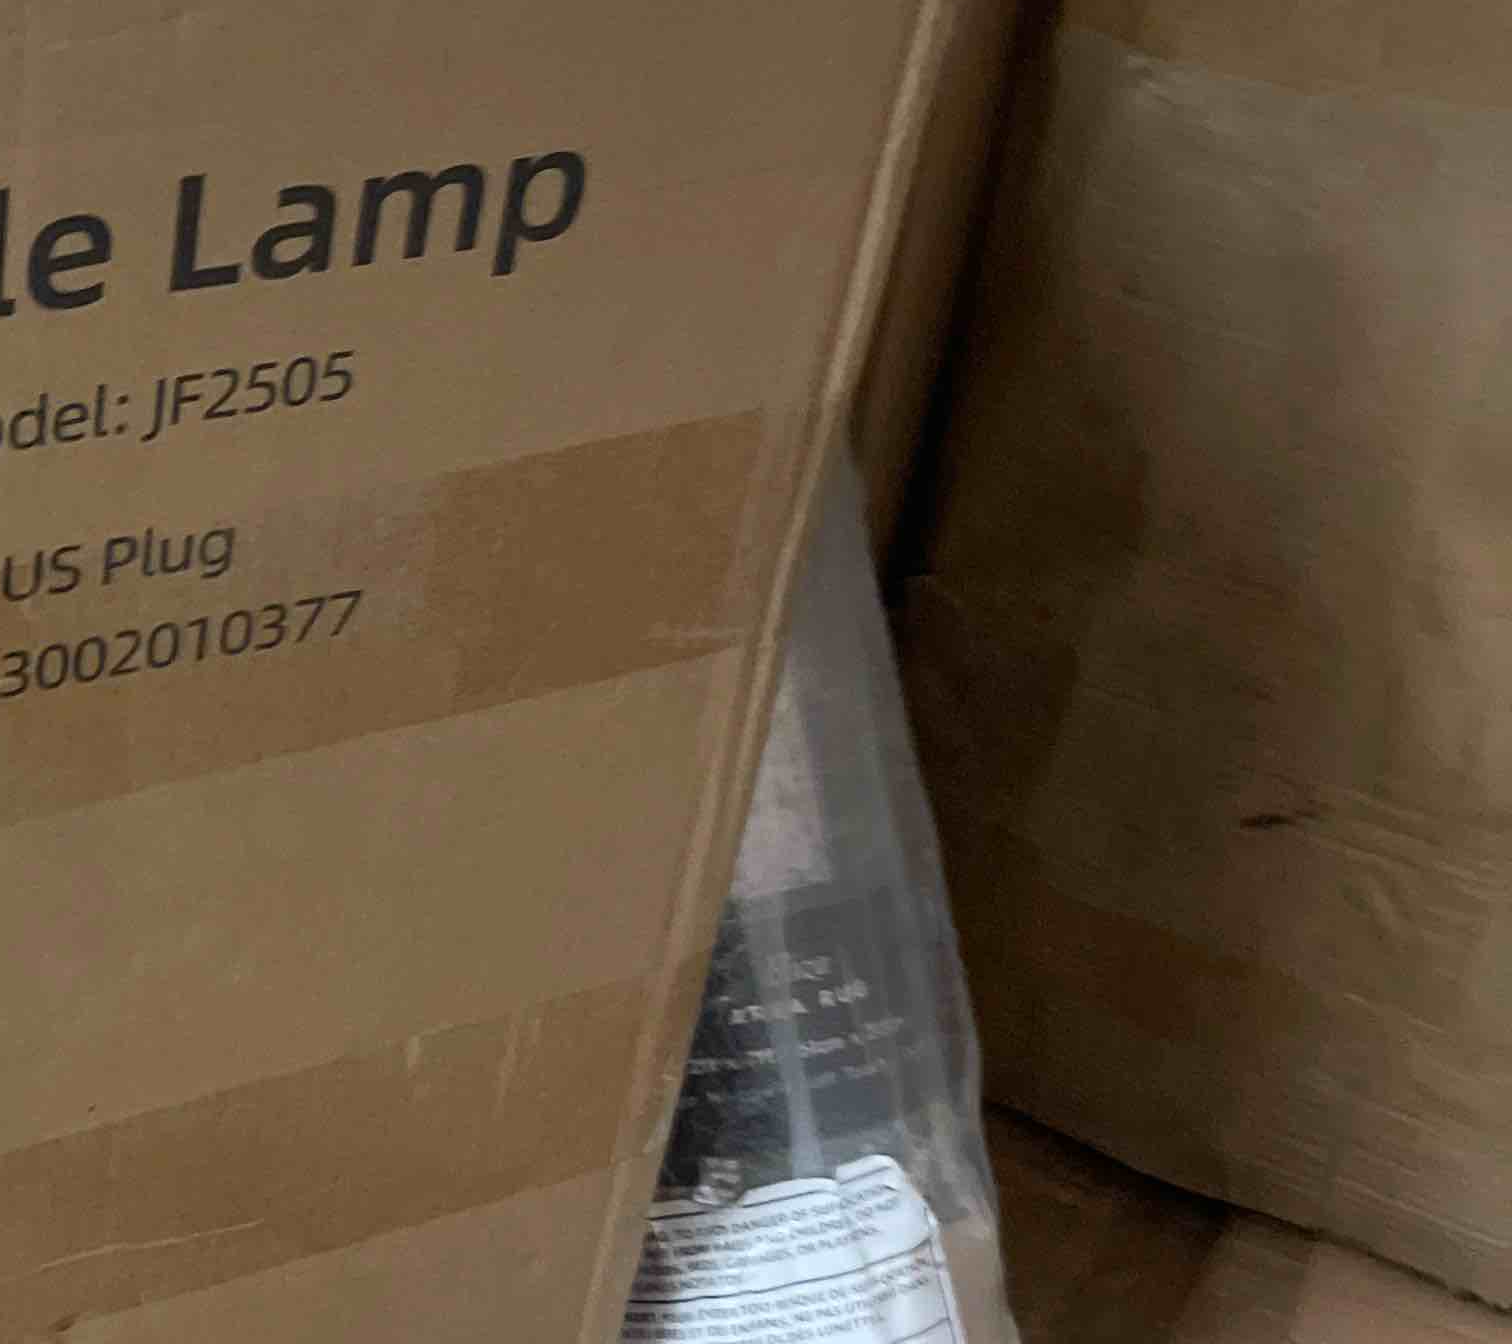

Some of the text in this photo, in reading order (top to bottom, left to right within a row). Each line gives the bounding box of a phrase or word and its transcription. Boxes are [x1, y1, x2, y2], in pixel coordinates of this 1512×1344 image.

[168, 145, 586, 293] Lamp
[139, 350, 355, 443] JF2505
[1, 524, 234, 603] US Plug
